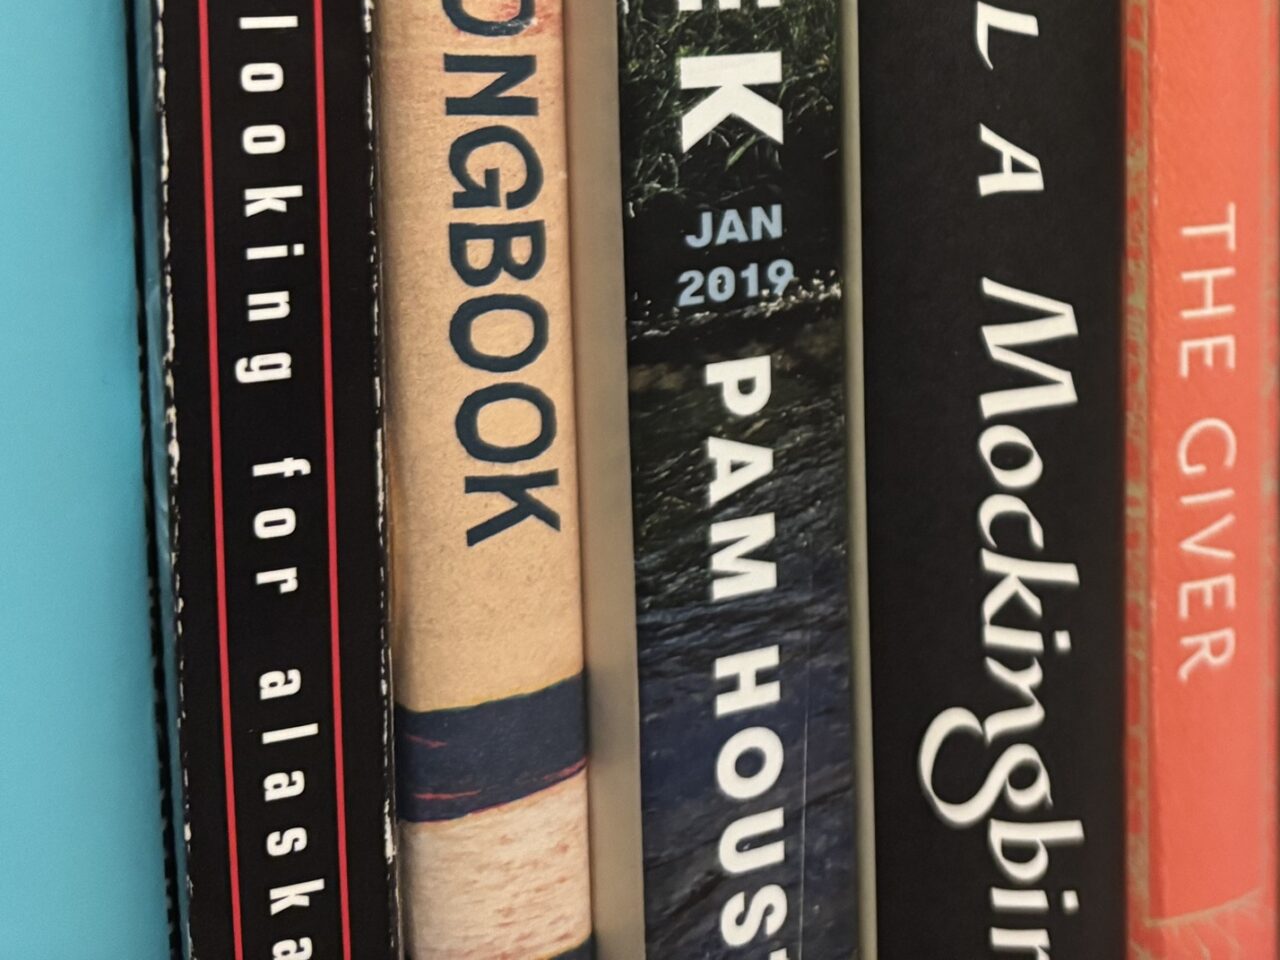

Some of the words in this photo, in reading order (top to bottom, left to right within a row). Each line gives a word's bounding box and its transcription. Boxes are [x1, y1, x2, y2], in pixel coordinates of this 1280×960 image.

[235, 15, 305, 385] looking
[686, 204, 784, 248] JAN
[977, 122, 1046, 197] A
[677, 258, 796, 308] 2019
[1178, 201, 1238, 379] THE
[252, 456, 312, 594] for
[704, 354, 778, 601] PAM
[1176, 418, 1239, 683] GIVER
[258, 667, 326, 960] alaska
[713, 644, 789, 960] HOUS
